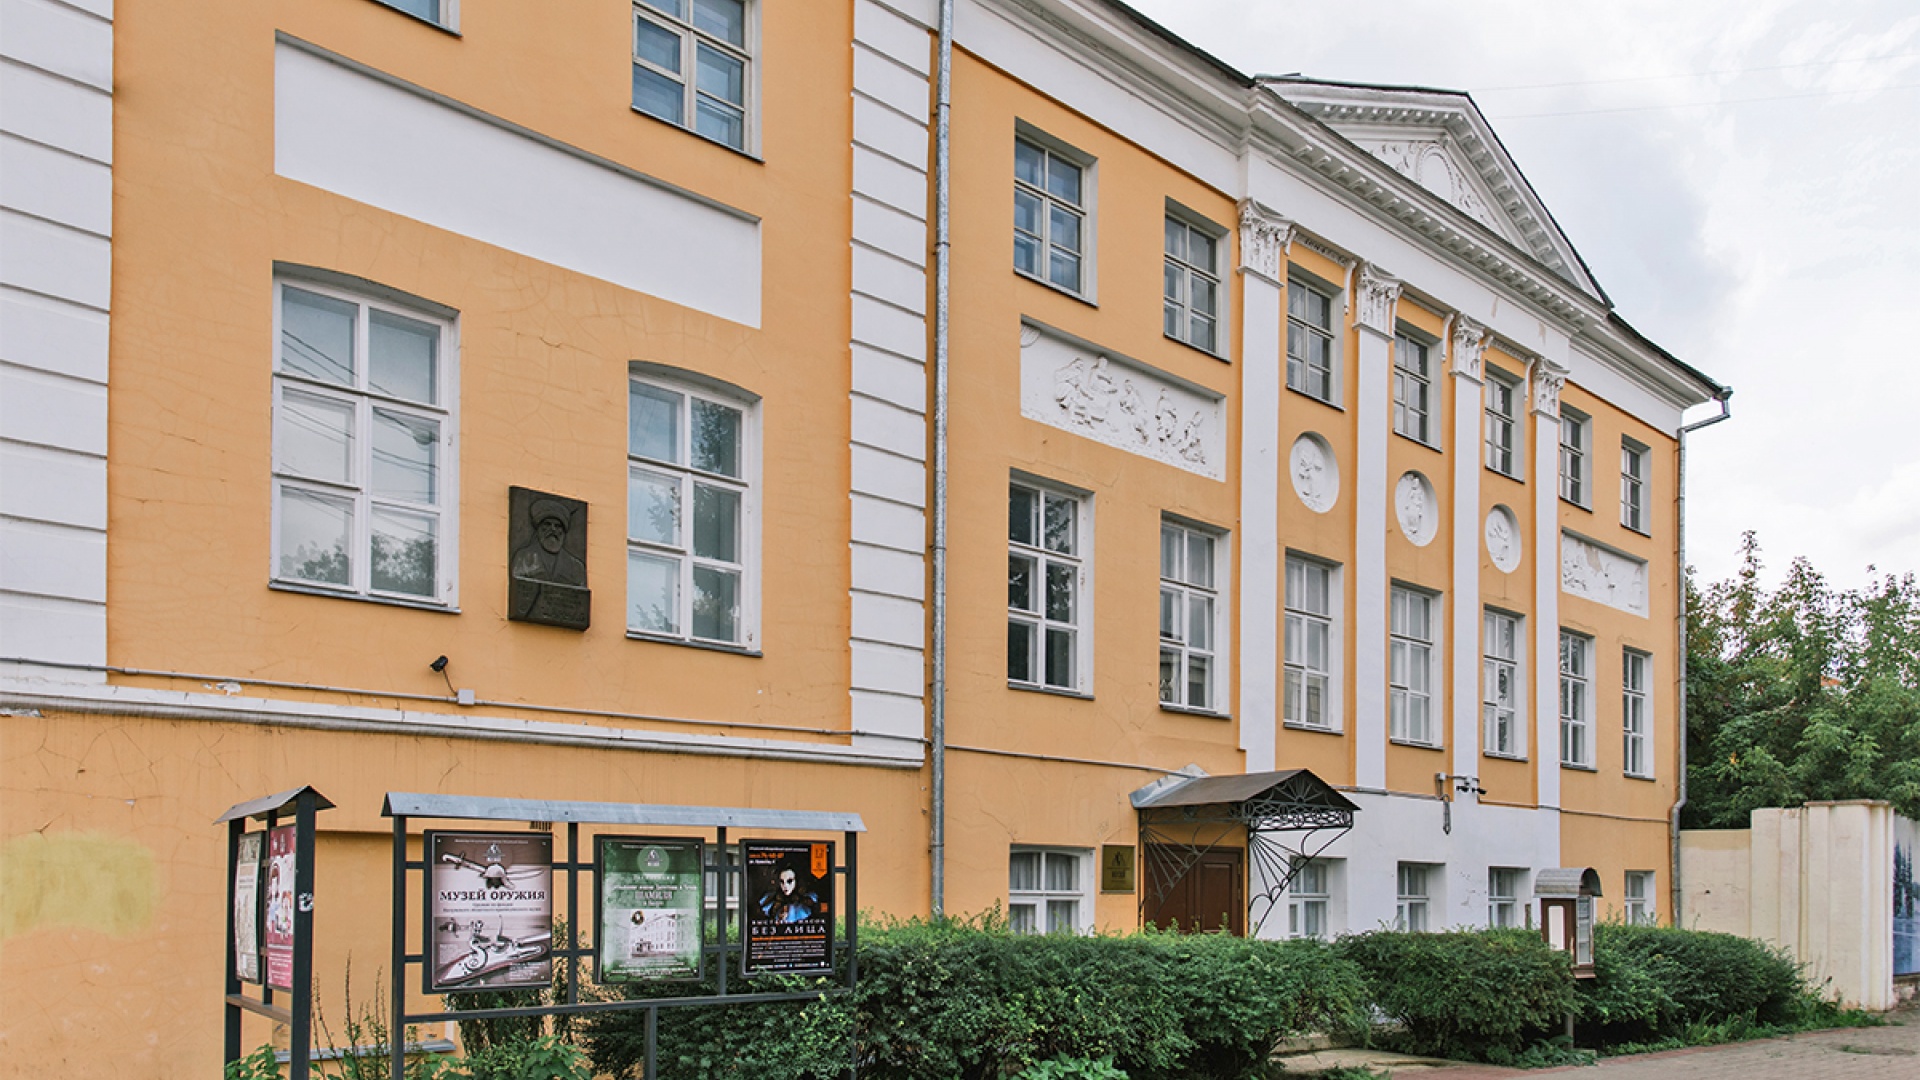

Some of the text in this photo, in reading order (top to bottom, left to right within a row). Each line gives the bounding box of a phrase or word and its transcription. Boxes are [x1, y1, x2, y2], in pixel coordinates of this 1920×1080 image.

[439, 889, 545, 901] МУЗЕЙ ОРУЖИЯ
[751, 925, 826, 935] БЕЗ ЛИЦА
